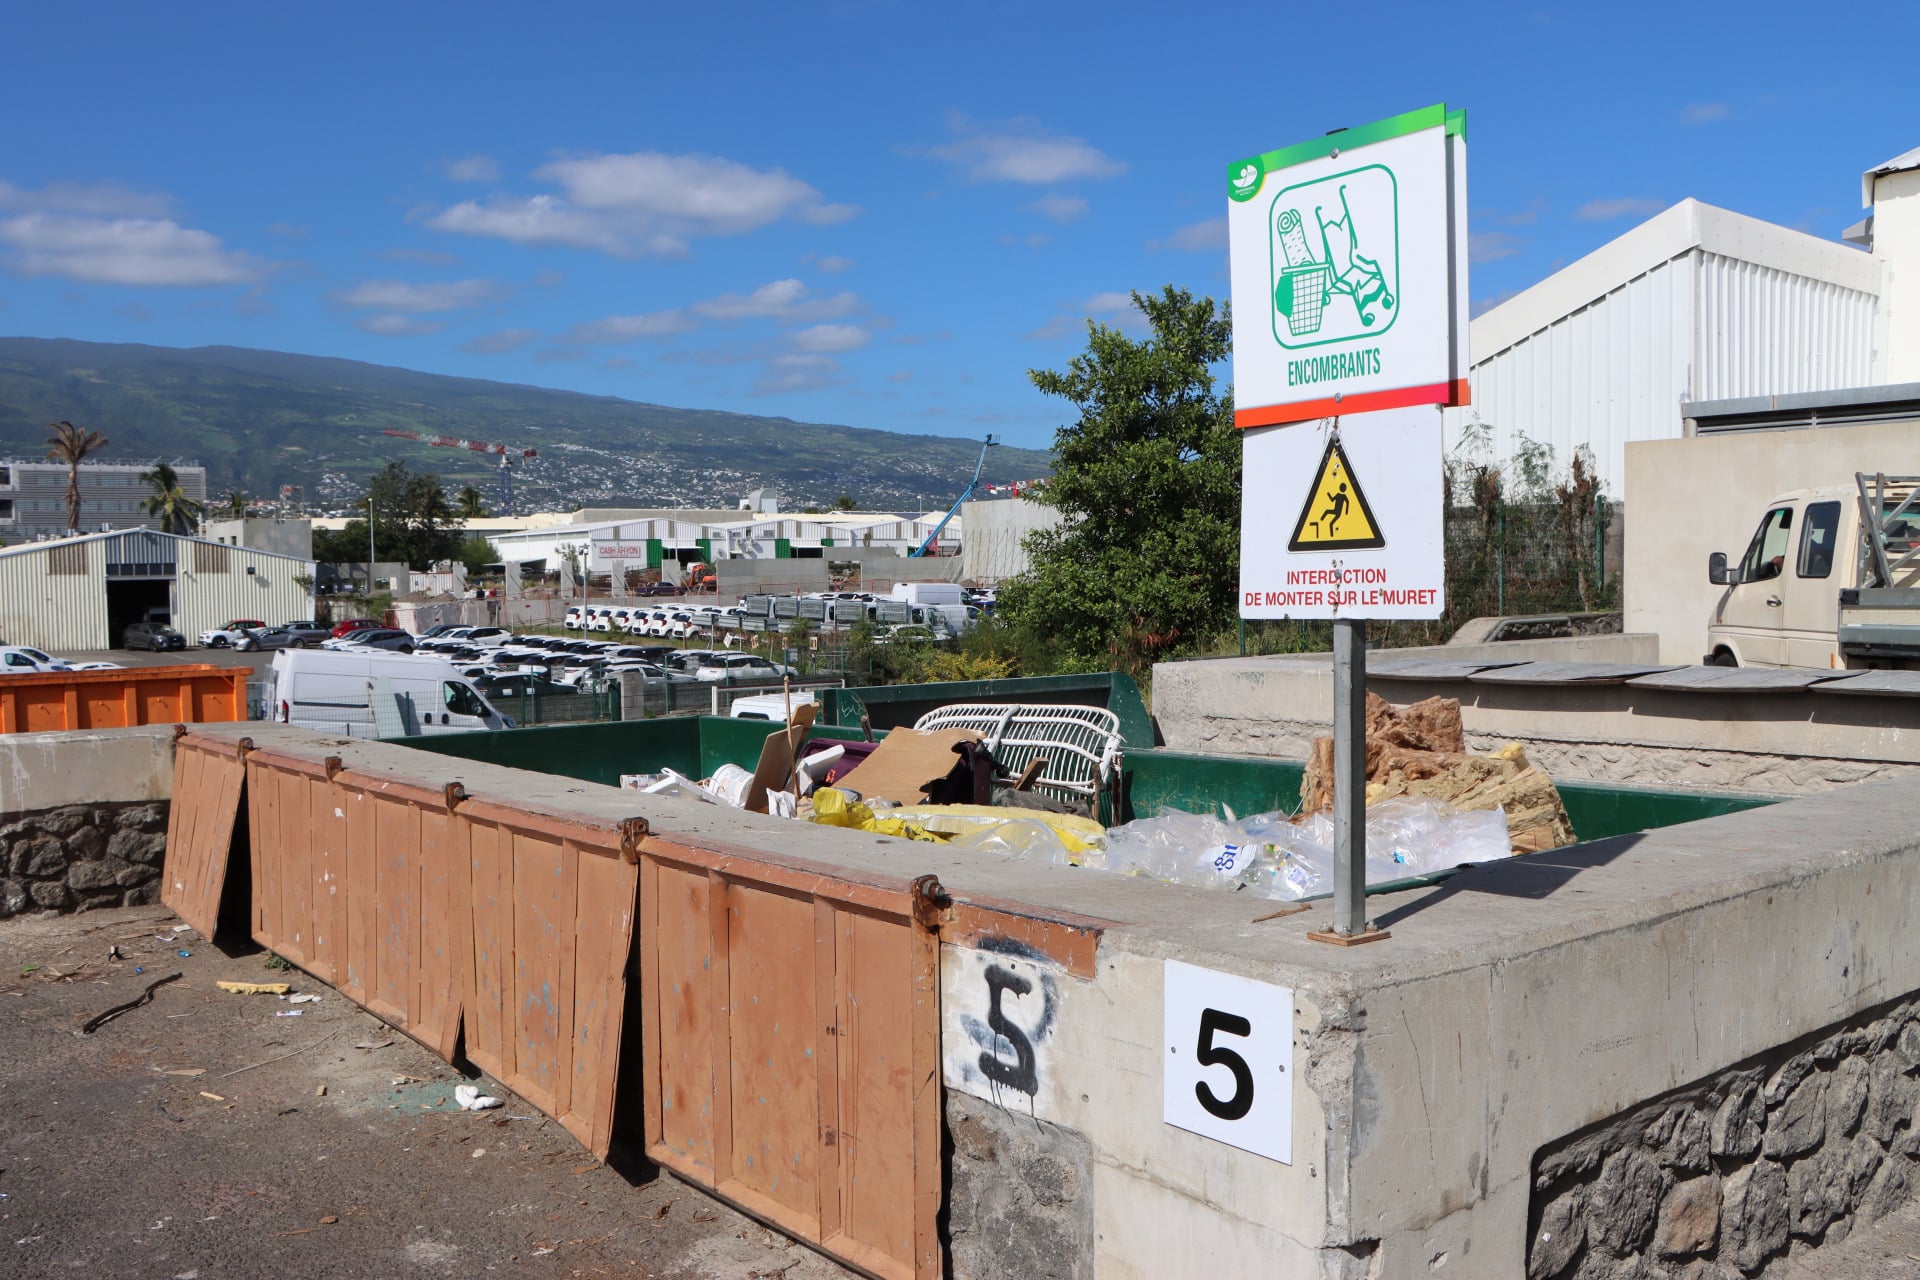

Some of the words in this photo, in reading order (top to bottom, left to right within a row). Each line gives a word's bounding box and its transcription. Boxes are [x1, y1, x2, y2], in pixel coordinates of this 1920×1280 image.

[1288, 347, 1381, 387] ENCOMBRANTS
[600, 546, 616, 555] CASH
[1245, 592, 1262, 606] DE
[1265, 591, 1323, 606] MONTER
[1327, 590, 1357, 606] SUR
[1361, 590, 1379, 605] LE
[1382, 589, 1437, 605] MURET
[1194, 1007, 1255, 1120] 5
